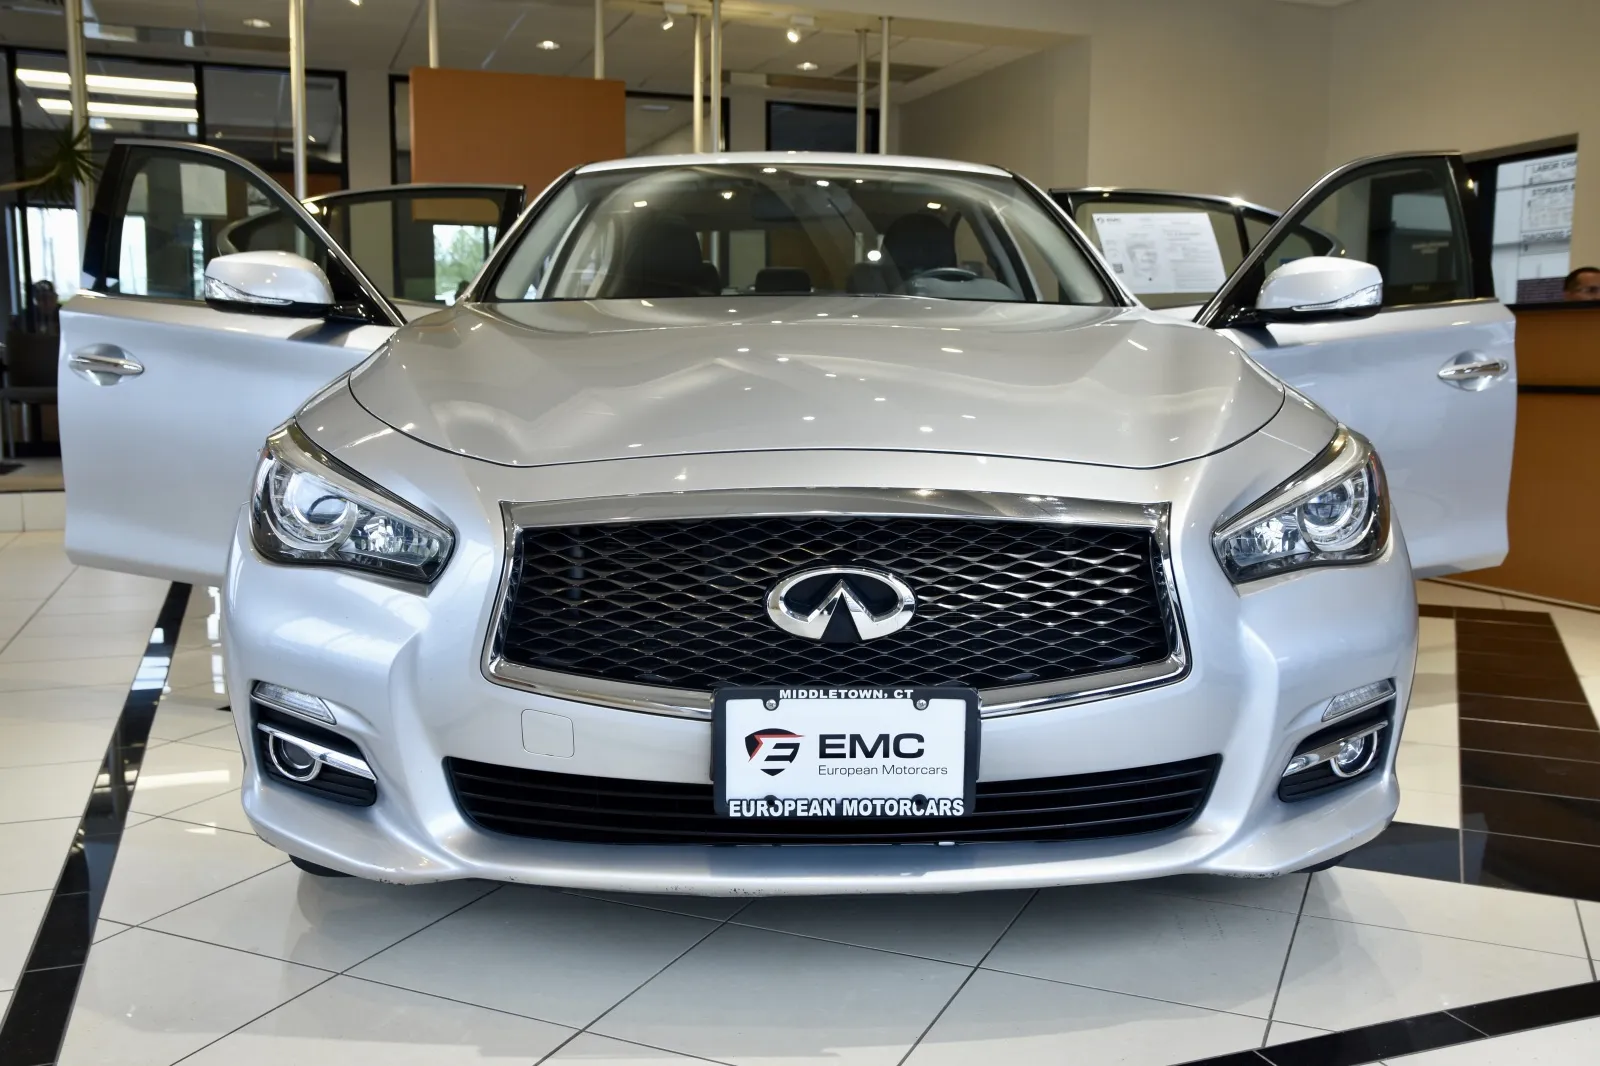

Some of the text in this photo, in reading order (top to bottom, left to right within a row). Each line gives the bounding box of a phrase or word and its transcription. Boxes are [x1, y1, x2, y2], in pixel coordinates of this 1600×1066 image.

[1533, 161, 1559, 173] LABOR
[1532, 184, 1568, 196] STORAGE
[779, 689, 914, 700] MIDDLETOWN, CT
[818, 733, 925, 759] EMC
[818, 764, 948, 777] European Motorcars
[729, 798, 965, 817] EUROPEAN MOTORCARS
